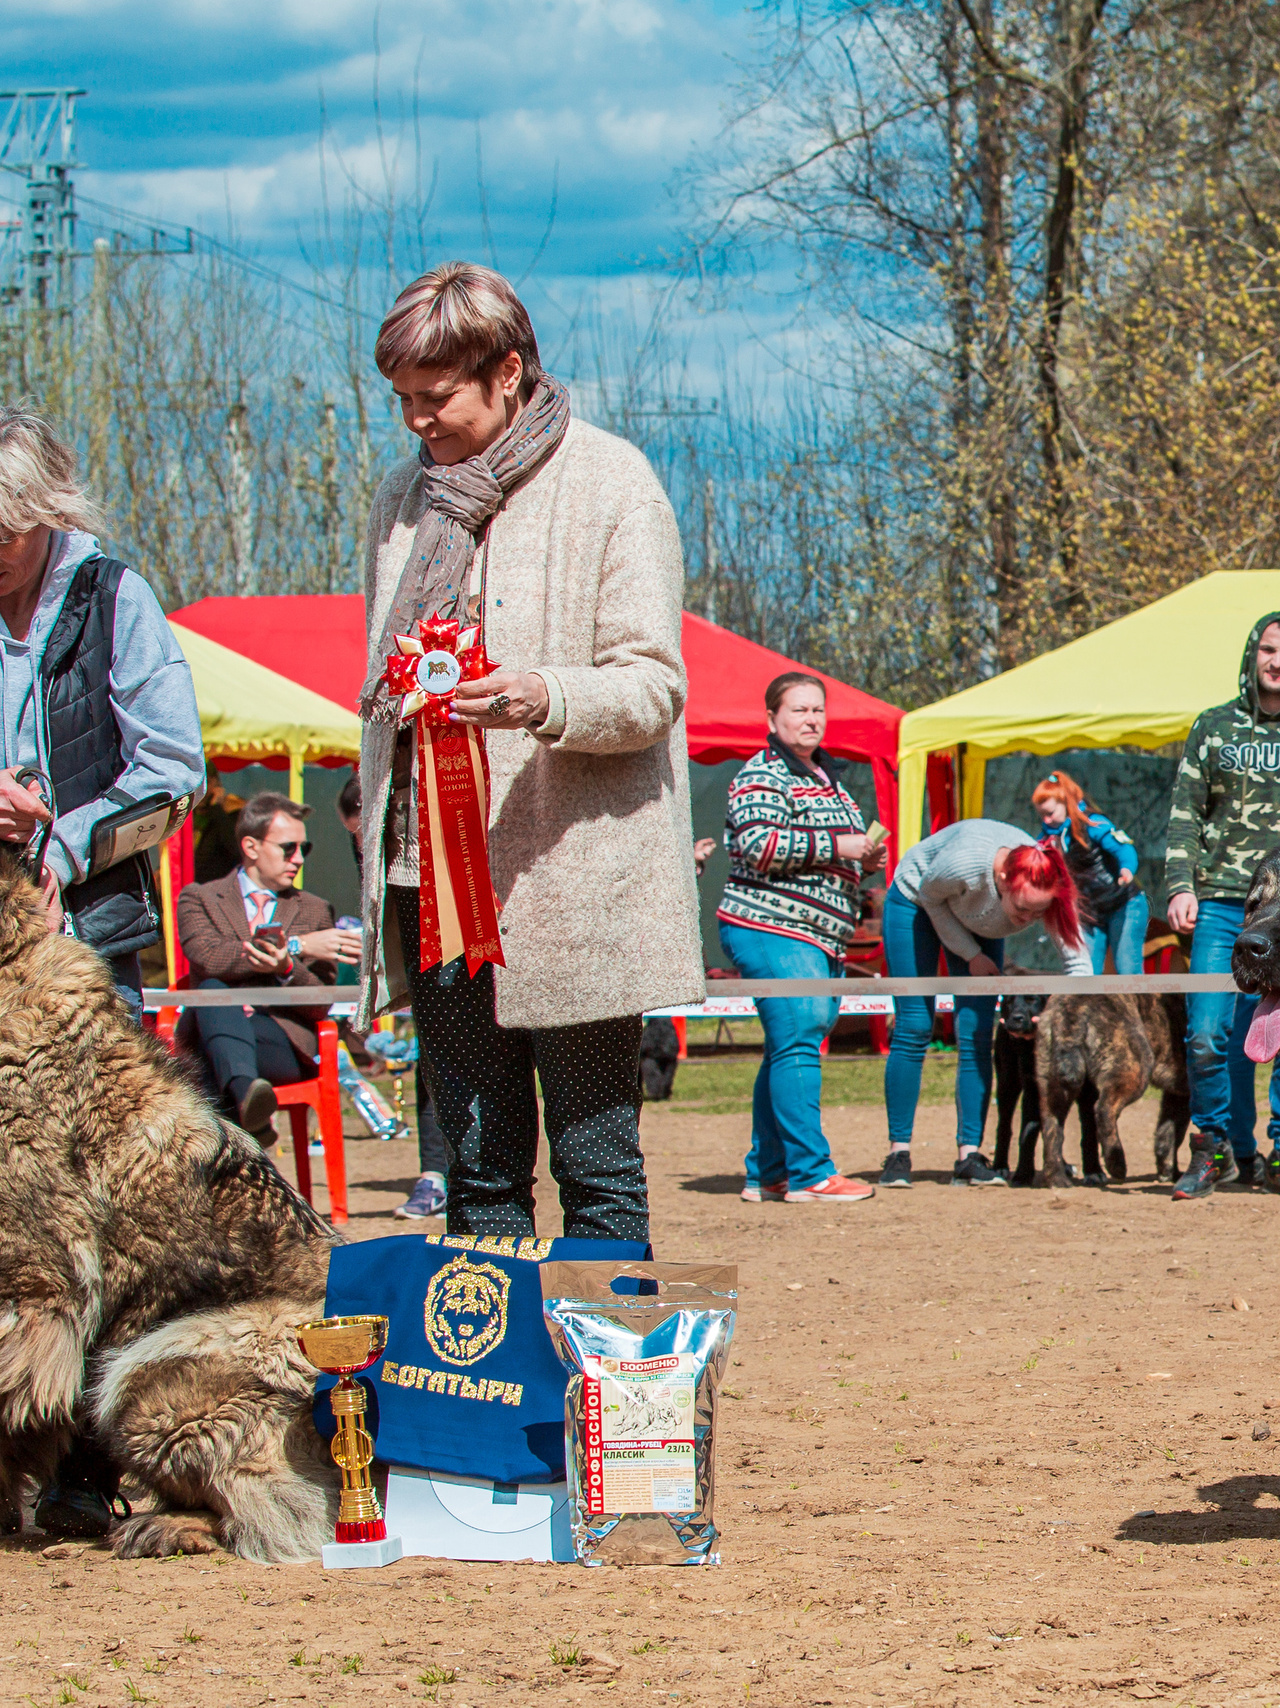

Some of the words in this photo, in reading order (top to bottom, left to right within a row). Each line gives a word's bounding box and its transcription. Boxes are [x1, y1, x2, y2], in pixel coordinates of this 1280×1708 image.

[443, 773, 469, 781] МКОО
[465, 864, 481, 919] ЧЕМПИОНЫ
[736, 1004, 758, 1013] CAN
[622, 1358, 678, 1371] ЗООМЕНЮ
[381, 1360, 523, 1406] БОГАТЫРИ
[667, 1445, 690, 1453] 23/12
[603, 1451, 645, 1459] КЛАССИК
